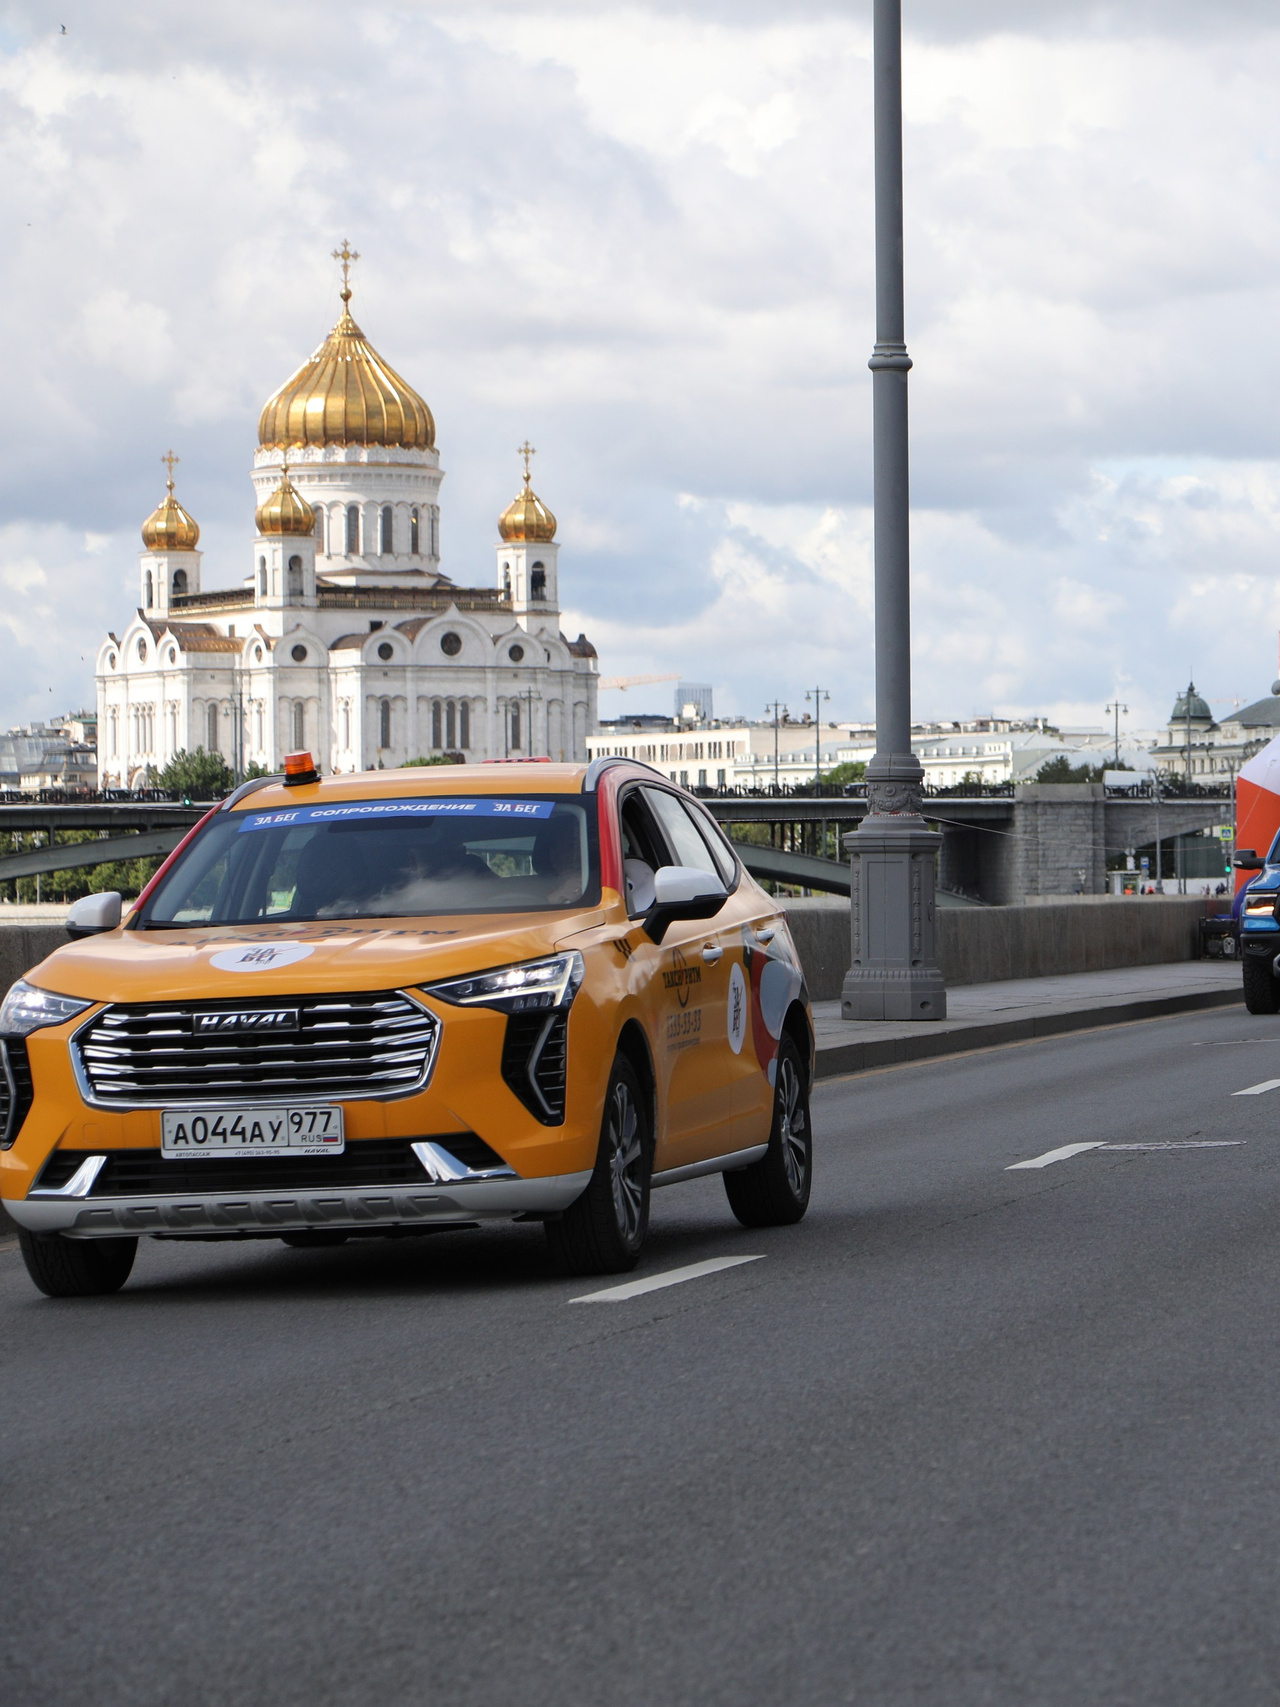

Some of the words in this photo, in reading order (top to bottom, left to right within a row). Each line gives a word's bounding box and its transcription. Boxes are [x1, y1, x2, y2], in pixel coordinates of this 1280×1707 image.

[310, 803, 476, 818] СОПРОВОЖДЕНИЕ
[200, 1013, 293, 1031] HAVAL
[173, 1115, 283, 1146] А044АУ
[290, 1111, 332, 1134] 977
[301, 1135, 322, 1143] RUS
